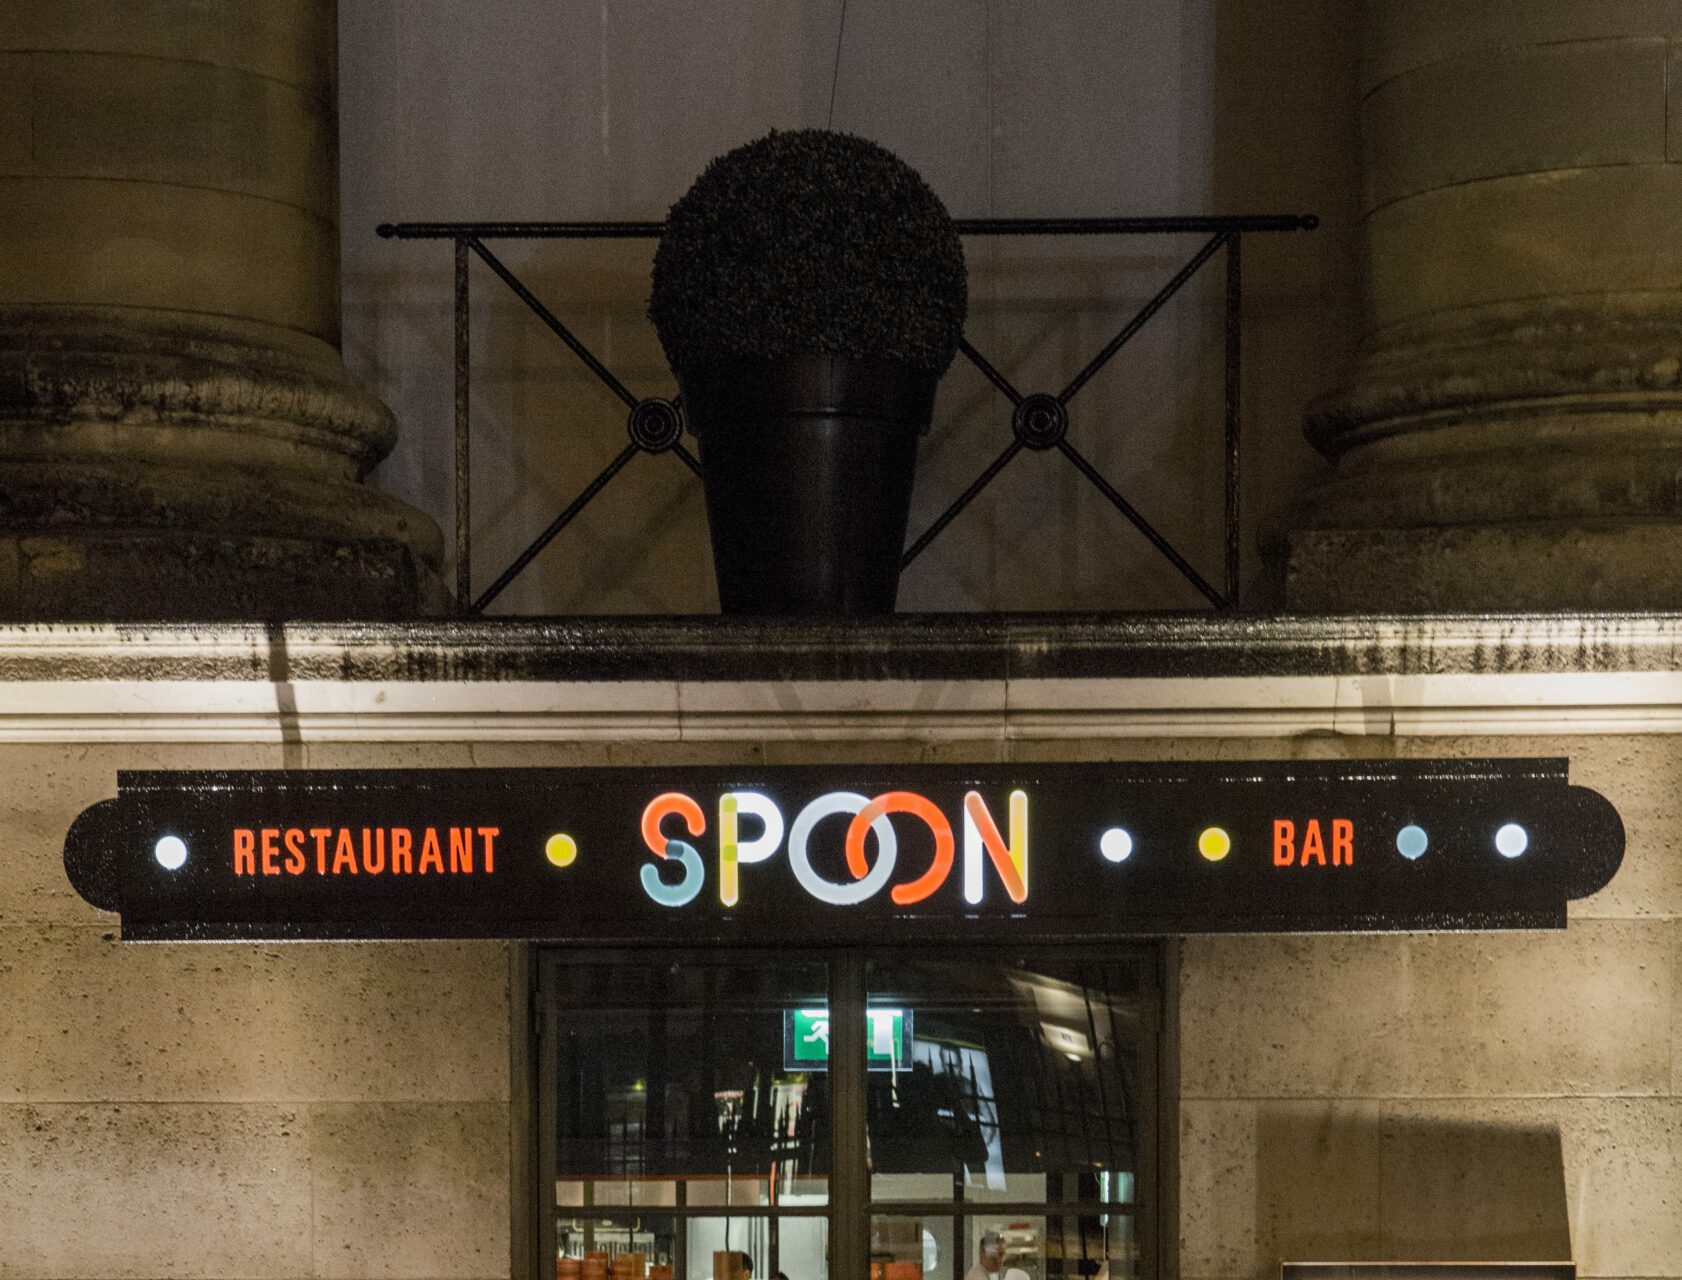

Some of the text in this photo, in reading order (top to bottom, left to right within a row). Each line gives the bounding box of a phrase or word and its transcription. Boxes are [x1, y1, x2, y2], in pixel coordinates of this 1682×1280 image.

[233, 790, 1353, 906] RESTAURANT SPOON BAR
